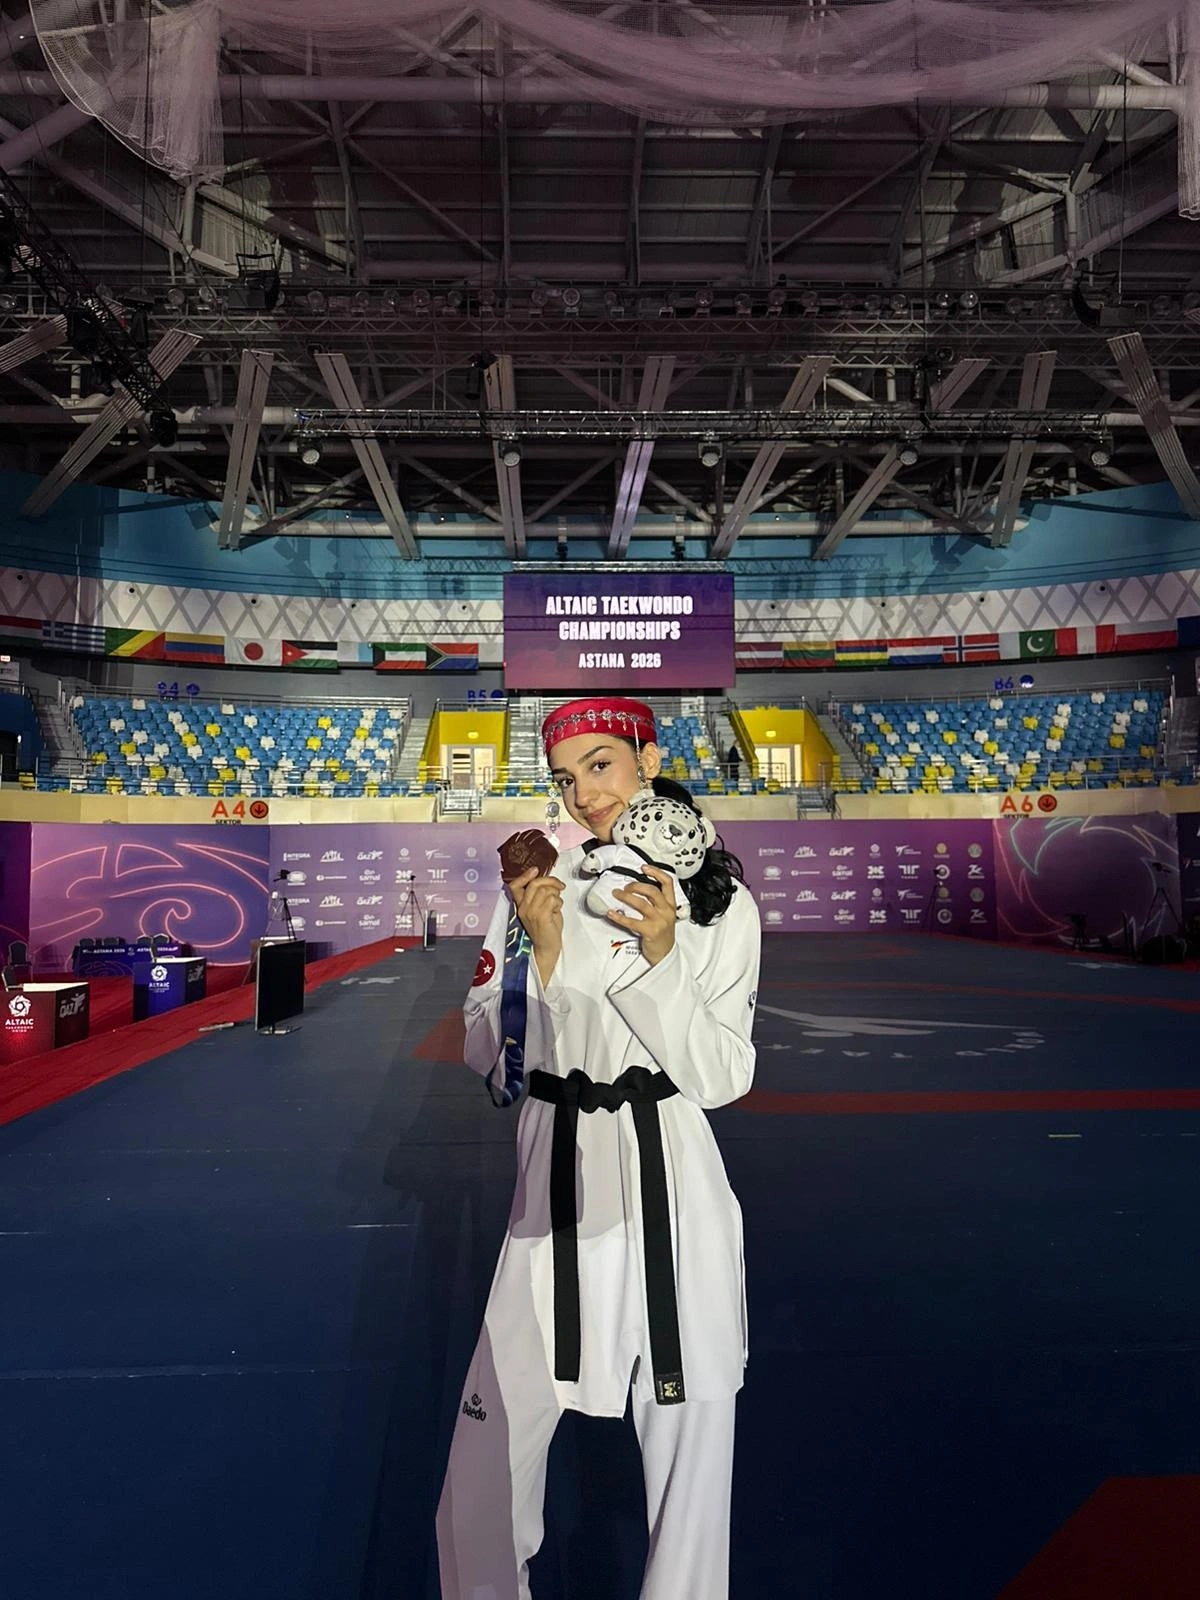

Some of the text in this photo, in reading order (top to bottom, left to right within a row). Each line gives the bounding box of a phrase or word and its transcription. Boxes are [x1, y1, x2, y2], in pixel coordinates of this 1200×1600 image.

[545, 596, 693, 615] ALTAIC TAEKWONDO
[559, 621, 681, 640] CHAMPIONSHIPS
[578, 653, 661, 668] ASTANA 2026
[5, 1018, 34, 1026] ALTAIC
[463, 1401, 487, 1421] Daedo
